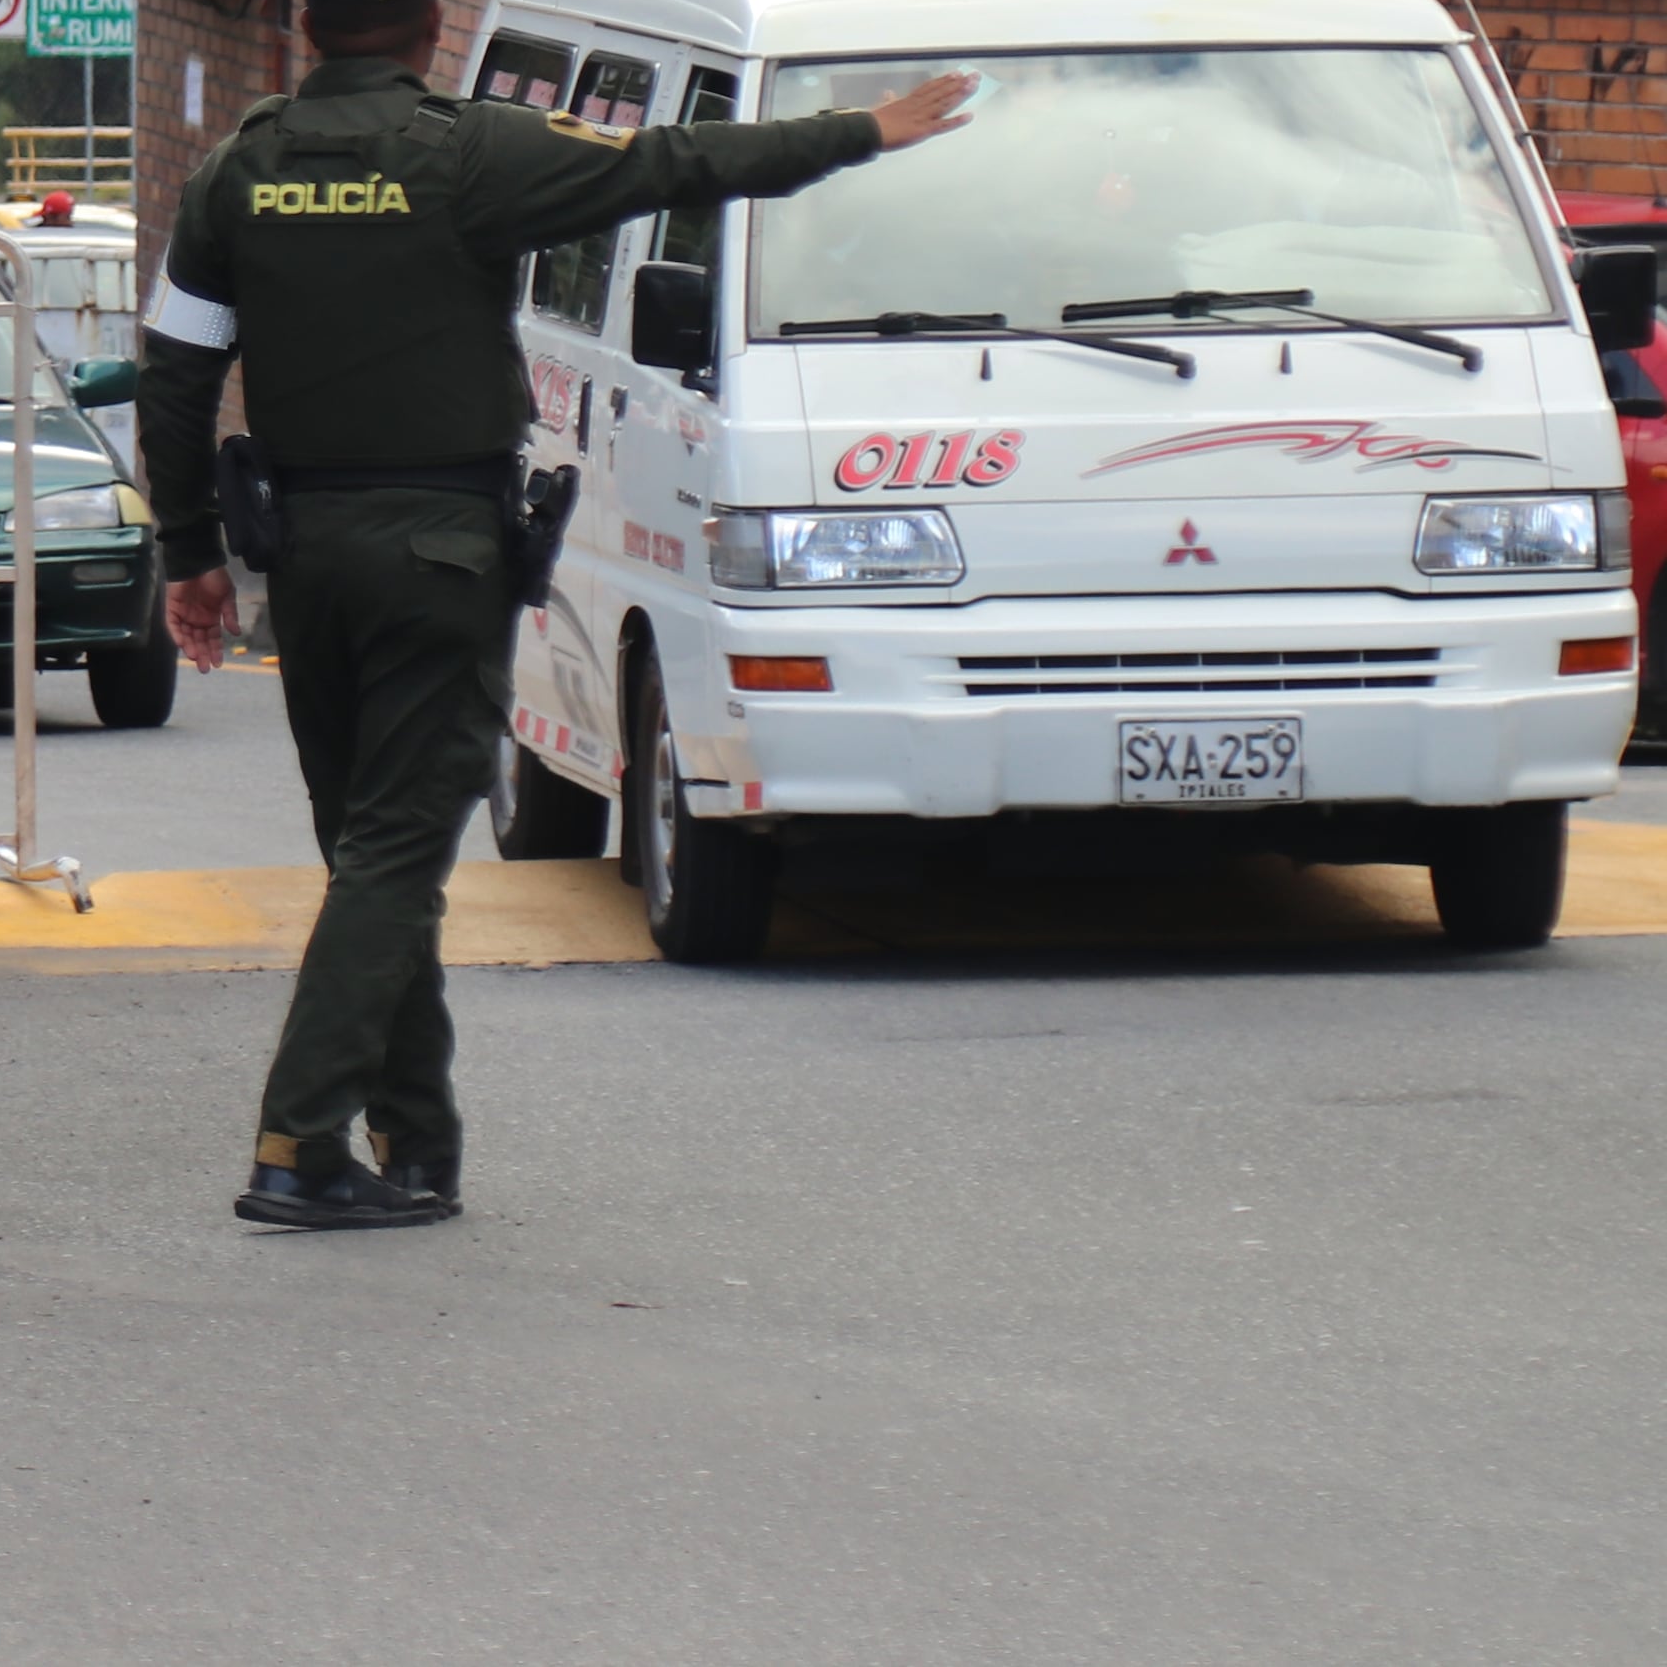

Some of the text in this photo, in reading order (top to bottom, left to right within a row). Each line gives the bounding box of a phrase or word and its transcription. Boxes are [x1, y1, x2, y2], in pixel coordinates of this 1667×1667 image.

[253, 172, 411, 216] POLICÍA
[834, 429, 1027, 493] 0118
[1178, 784, 1247, 799] IPIALES
